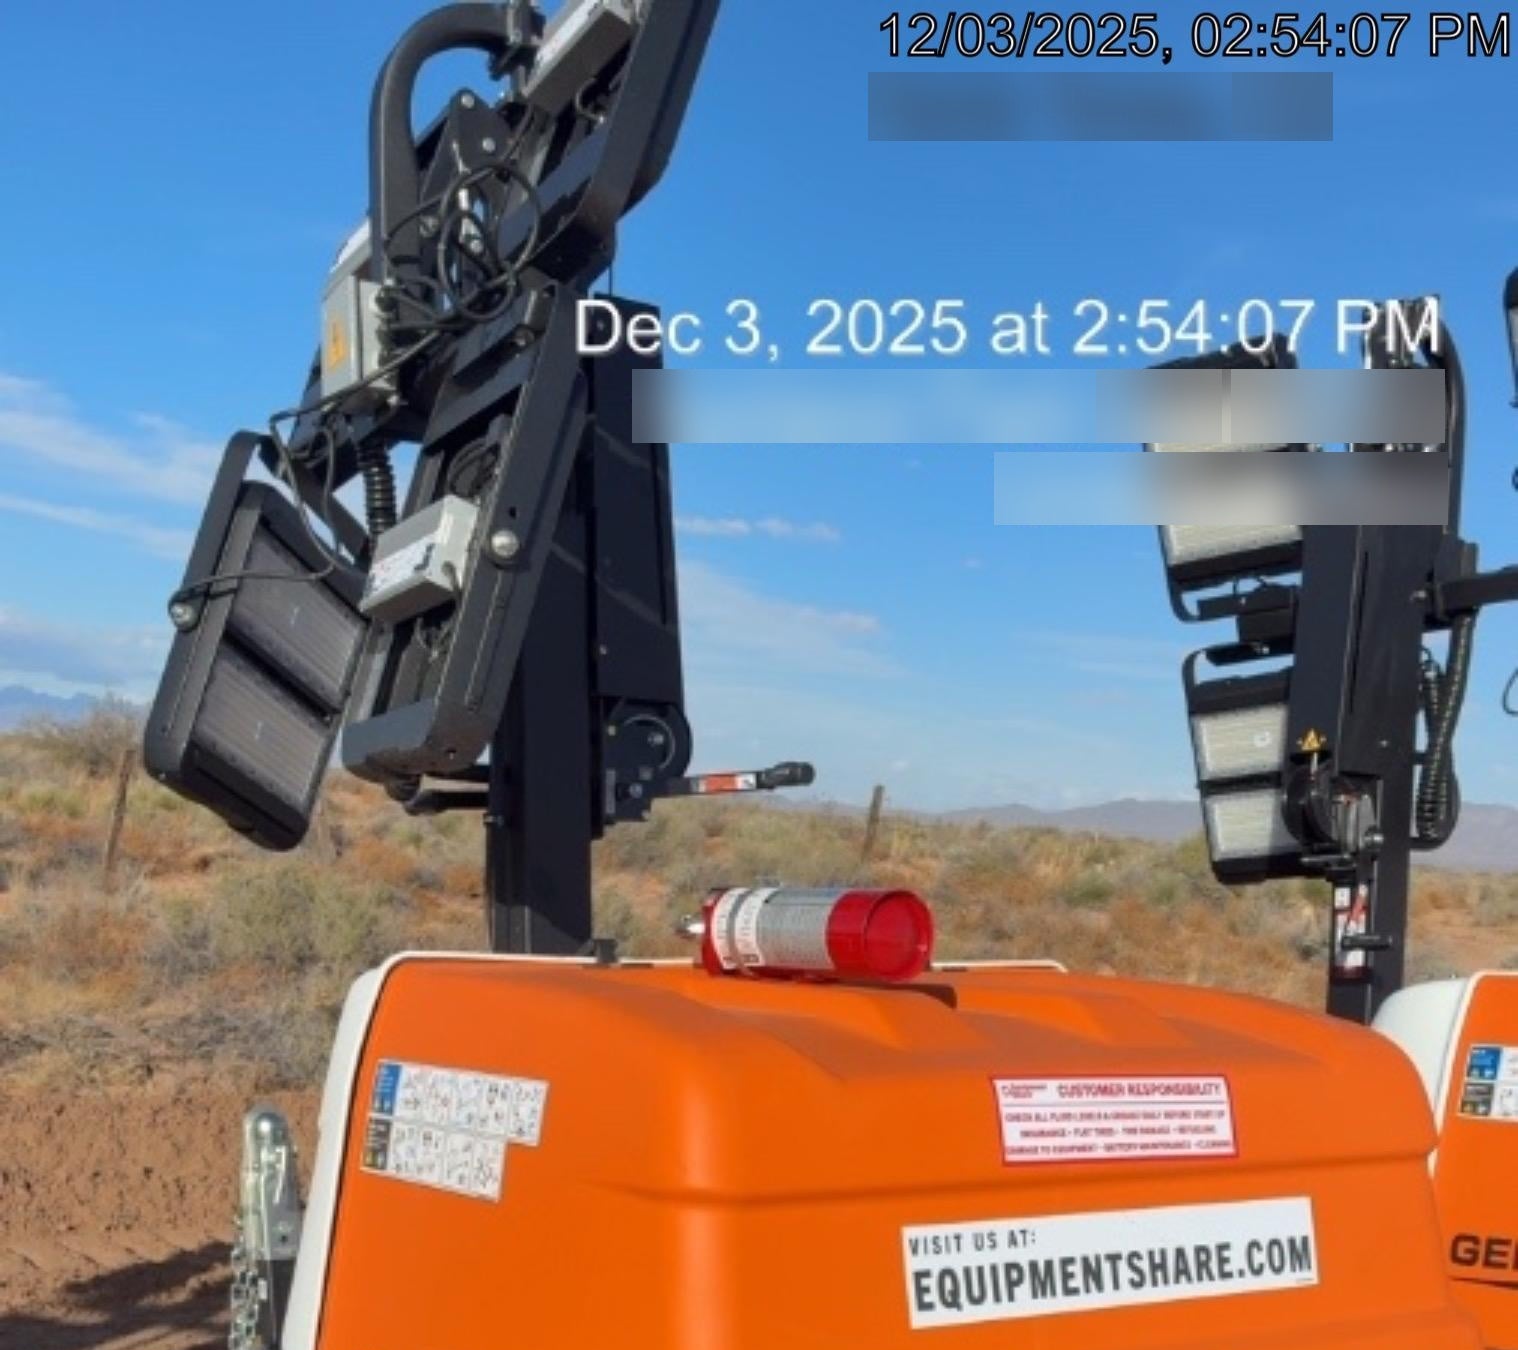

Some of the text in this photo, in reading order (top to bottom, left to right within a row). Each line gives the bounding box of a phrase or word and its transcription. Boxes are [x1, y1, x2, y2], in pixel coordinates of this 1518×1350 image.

[1056, 1082, 1125, 1099] CUSTOMER
[908, 1228, 1037, 1257] VISIT US AT:
[1450, 1234, 1518, 1271] GE
[912, 1235, 1313, 1312] EQUIPMENTSHARE.COM
